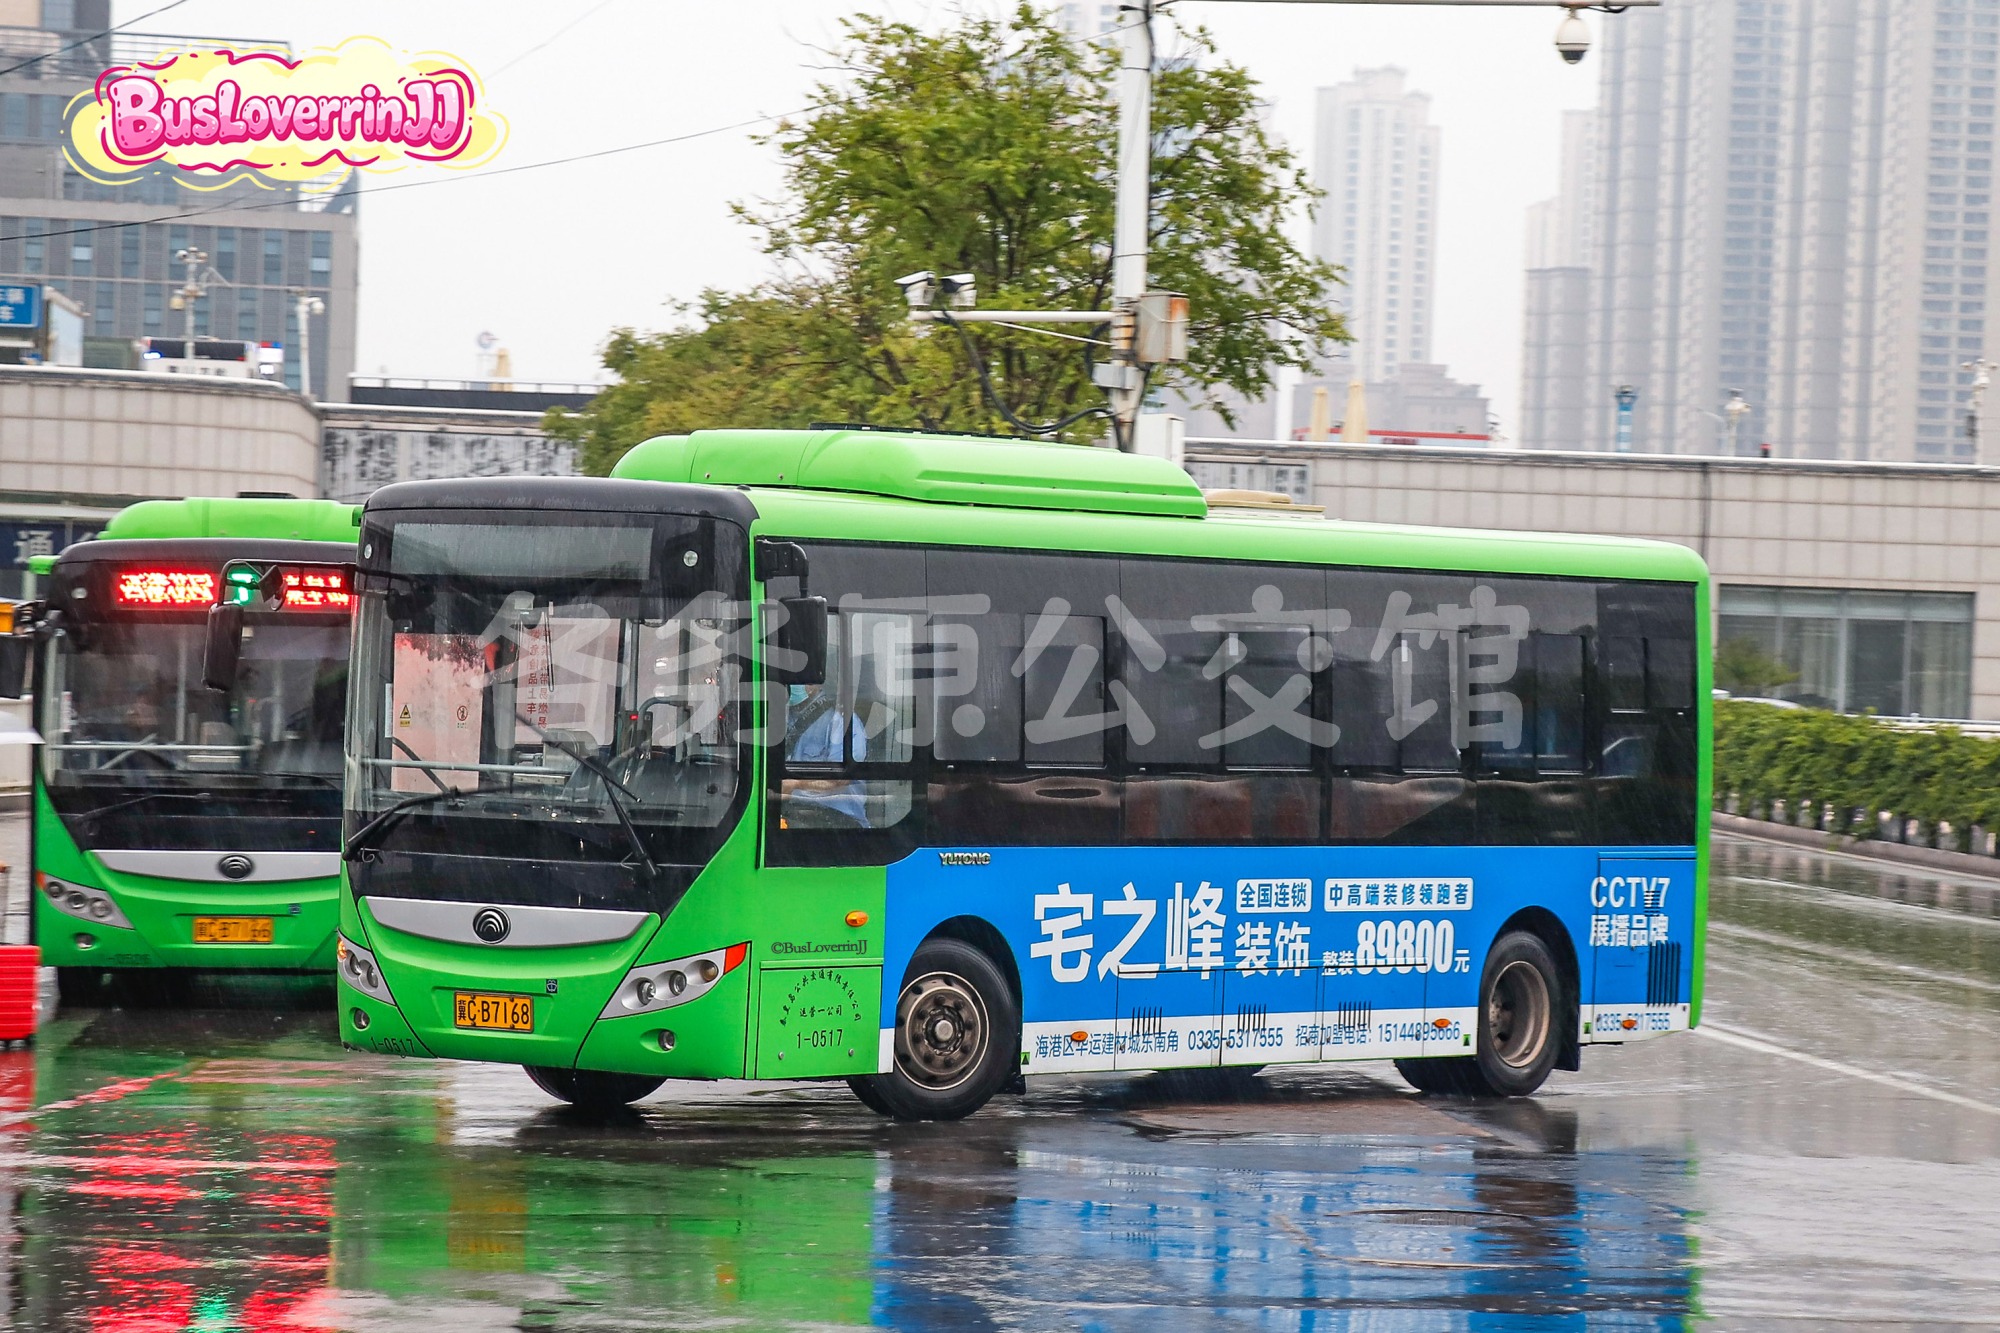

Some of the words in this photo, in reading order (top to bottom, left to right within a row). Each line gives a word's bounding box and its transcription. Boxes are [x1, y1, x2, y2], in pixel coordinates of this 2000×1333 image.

[939, 852, 991, 866] YUTONG
[1240, 882, 1308, 908] 全国连锁
[1329, 882, 1469, 907] 中高端装修领跑者
[1030, 881, 1227, 983] 宅之峰
[1589, 914, 1669, 946] 展播品牌
[1235, 920, 1311, 978] 装饰
[370, 1036, 415, 1053] 1-0517
[796, 1029, 843, 1049] 1-0517
[1188, 1027, 1283, 1050] 0335-5317555
